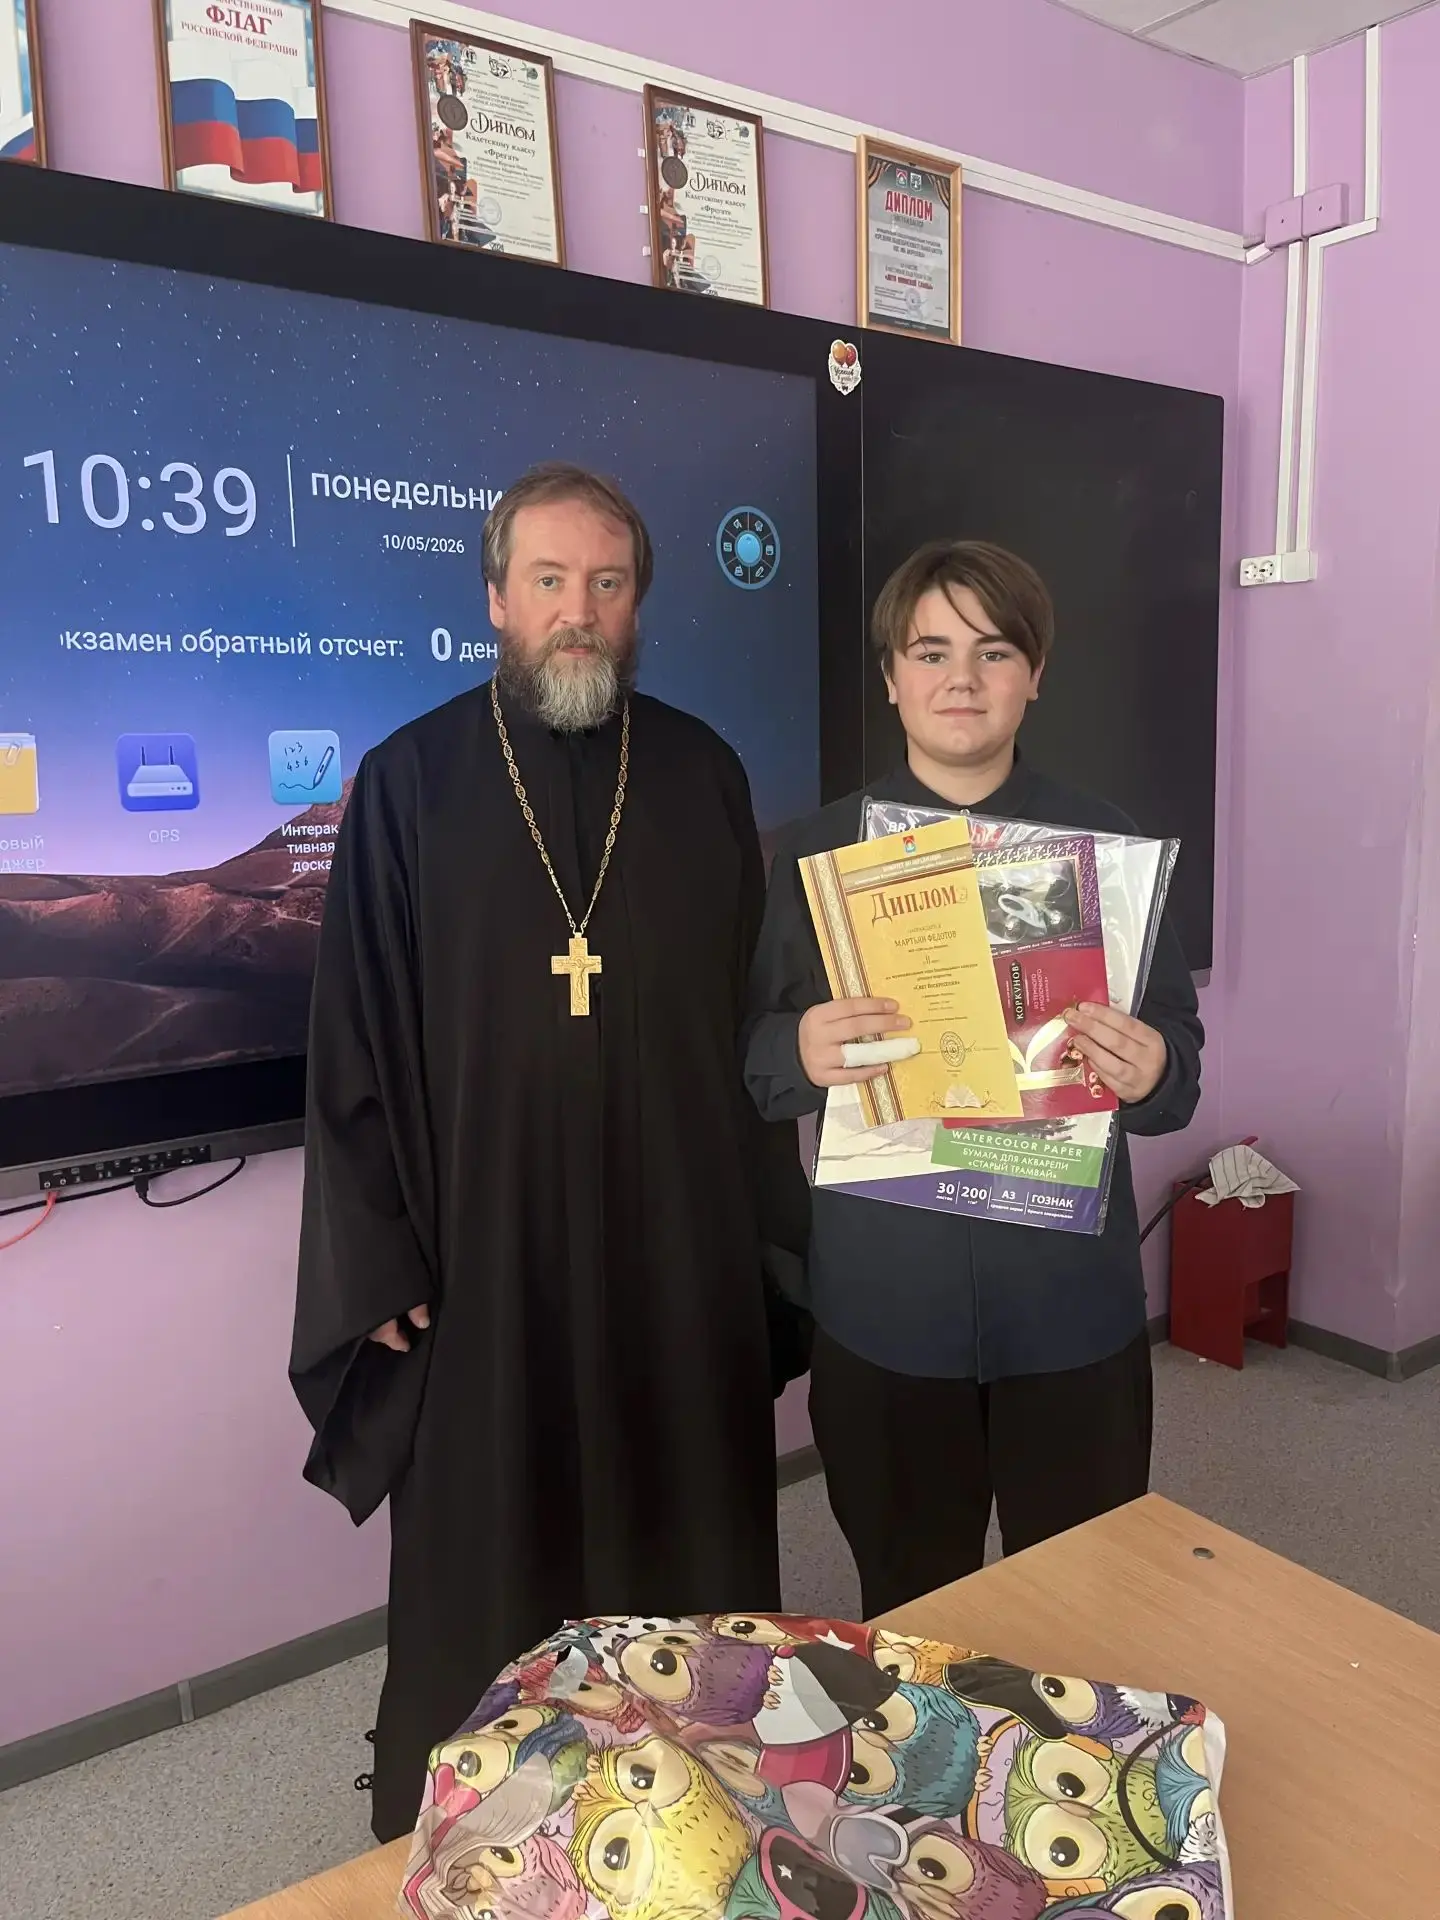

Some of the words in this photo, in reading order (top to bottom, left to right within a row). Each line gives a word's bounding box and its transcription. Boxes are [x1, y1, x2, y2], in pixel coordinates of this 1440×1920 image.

[206, 4, 273, 35] ФЛАГ
[181, 21, 243, 45] РОССИЙСКОЙ
[245, 37, 298, 57] ФЕДЕРАЦИИ
[466, 131, 510, 151] Кадетскому
[511, 143, 536, 158] классу
[685, 192, 723, 206] Кадетскому
[725, 199, 747, 209] классу
[885, 190, 933, 222] ДИПЛОМ
[23, 449, 257, 537] 10:39
[382, 534, 465, 554] 10/05/2026
[59, 630, 172, 652] кзамен
[182, 628, 311, 659] обратный
[319, 637, 404, 657] отсчет:
[431, 627, 452, 662] 0
[149, 829, 180, 843] OPS
[281, 824, 339, 838] Интерак
[888, 821, 922, 833] BRA
[286, 841, 336, 854] тивная
[292, 860, 333, 874] доска
[928, 930, 957, 943] ФЕДОТОВ
[952, 1130, 1038, 1151] WATERCOLOR
[1044, 1144, 1082, 1157] PAPER
[963, 1147, 998, 1161] БУМАГА
[1000, 1153, 1019, 1164] ДЛЯ
[1020, 1155, 1069, 1171] АКВАРЕЛИ
[968, 1159, 1008, 1172] «СТАРЫЙ
[1011, 1165, 1057, 1179] ТРАМВАЙ»
[937, 1182, 955, 1195] 30
[961, 1186, 988, 1200] 200
[1031, 1194, 1074, 1208] ГОЗНАК
